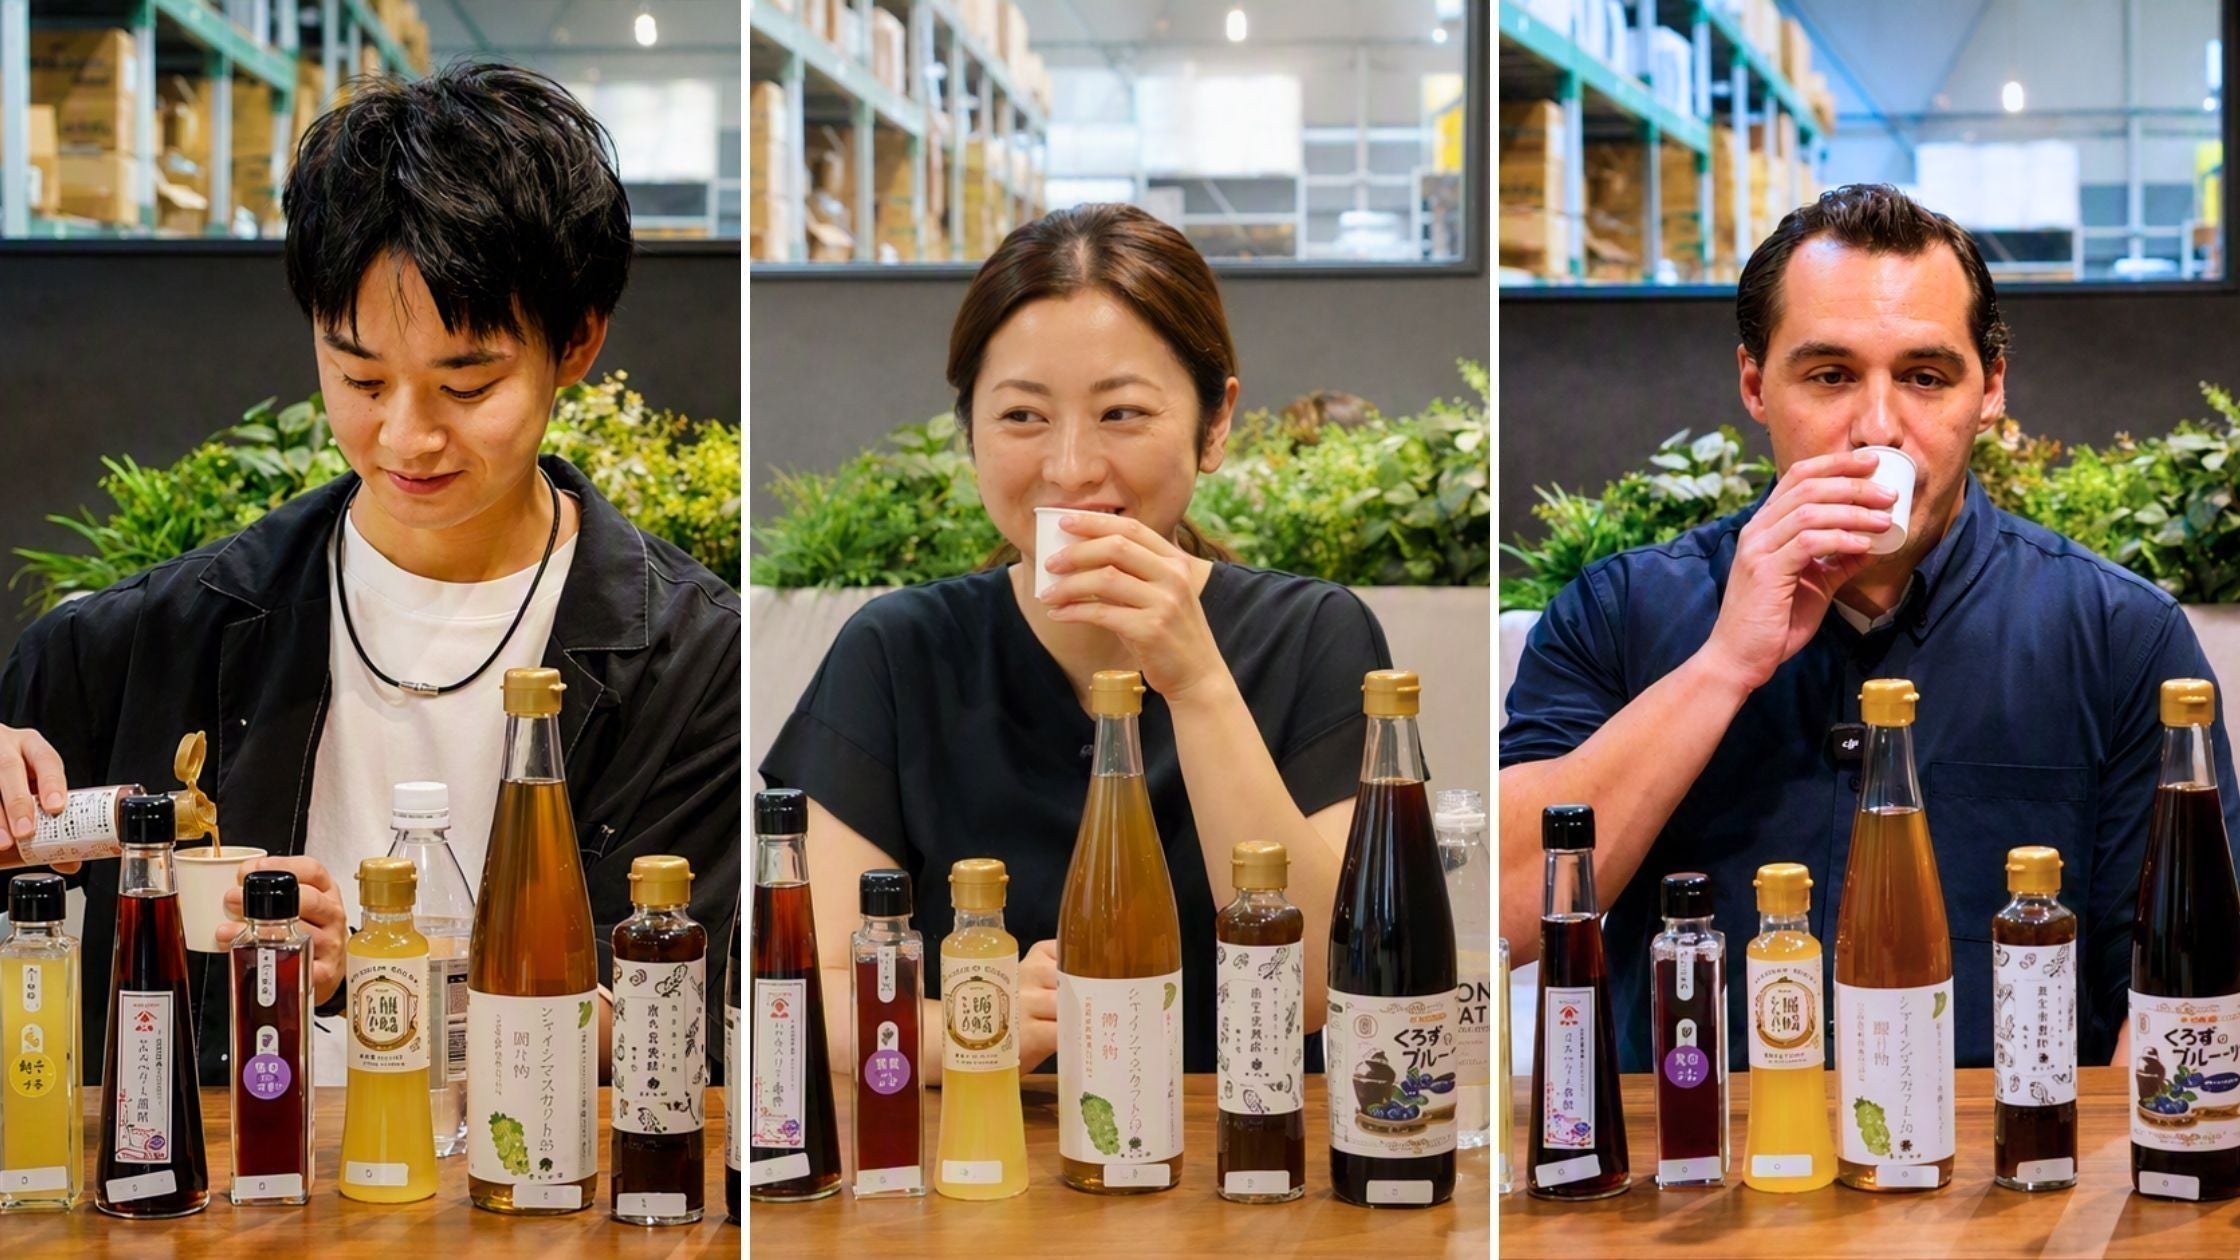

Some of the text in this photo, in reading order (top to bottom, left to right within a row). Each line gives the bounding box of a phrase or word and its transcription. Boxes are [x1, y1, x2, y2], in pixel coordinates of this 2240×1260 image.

[1457, 1005, 1488, 1025] AT
[1402, 1047, 1457, 1070] ブルー
